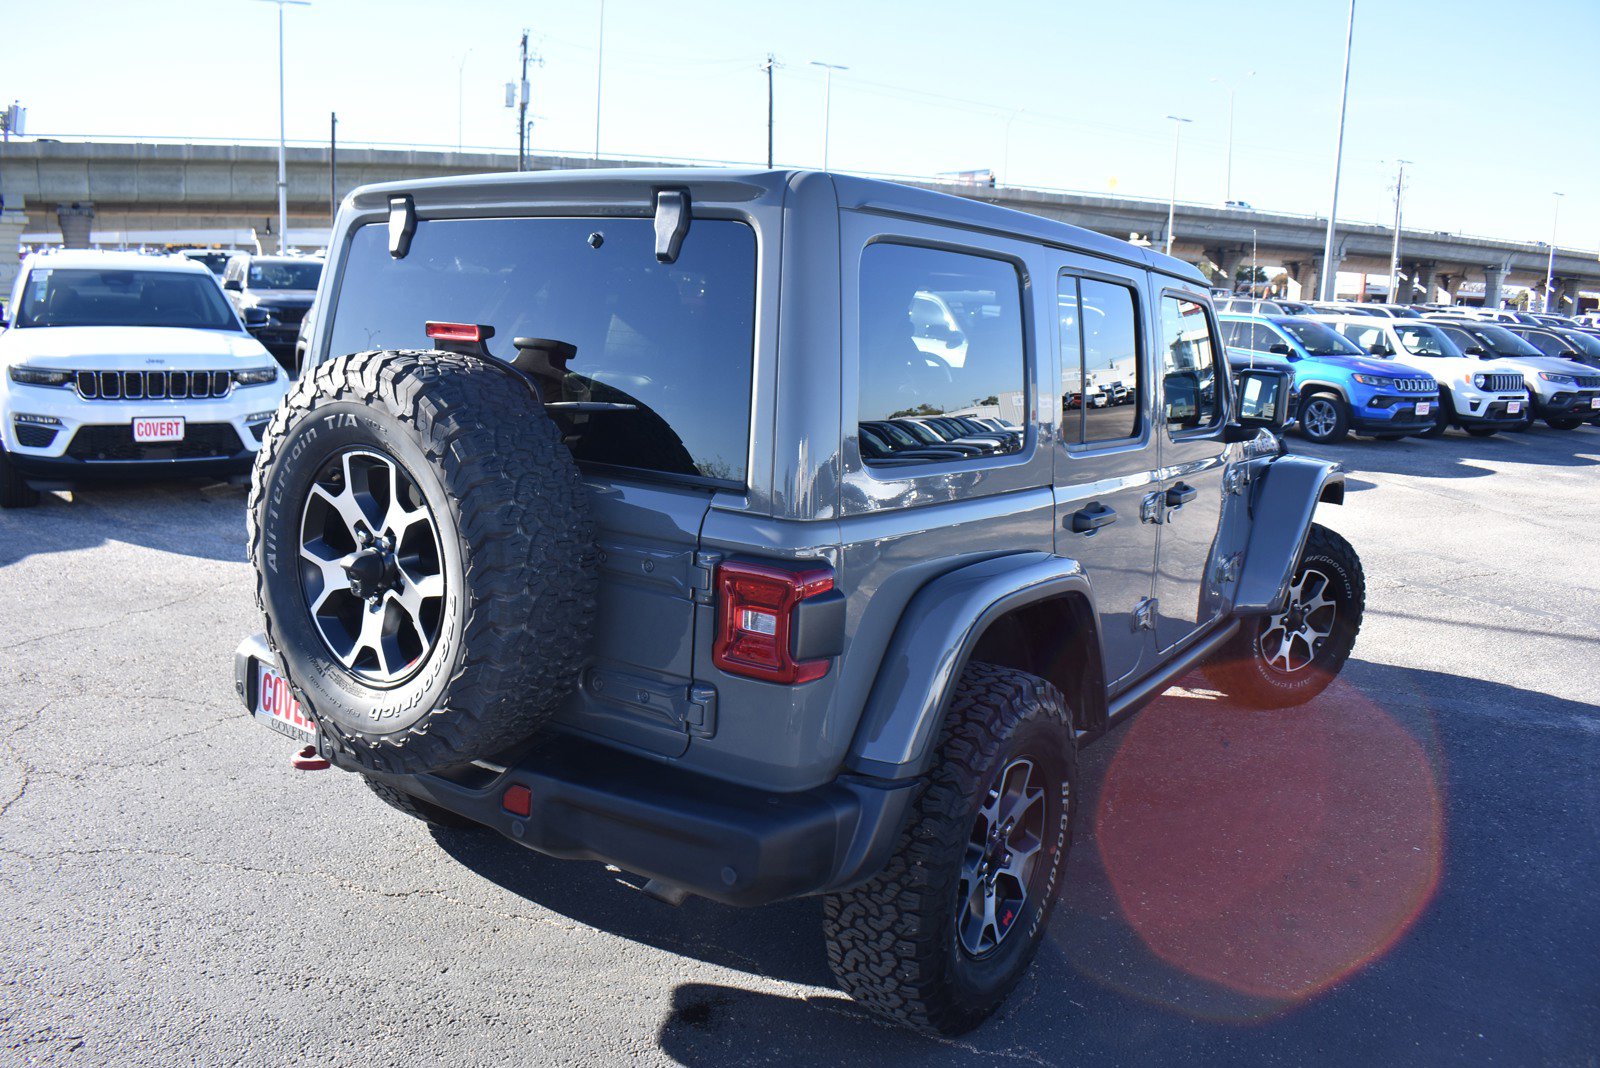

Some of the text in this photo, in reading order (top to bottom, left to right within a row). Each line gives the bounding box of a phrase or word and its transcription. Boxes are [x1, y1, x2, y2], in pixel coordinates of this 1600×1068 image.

[136, 422, 180, 436] COVERT
[267, 427, 318, 574] All-Terrain
[323, 413, 358, 431] T/A
[368, 594, 456, 721] BFGoodrich
[262, 672, 315, 731] COVE
[271, 718, 310, 743] COVERT
